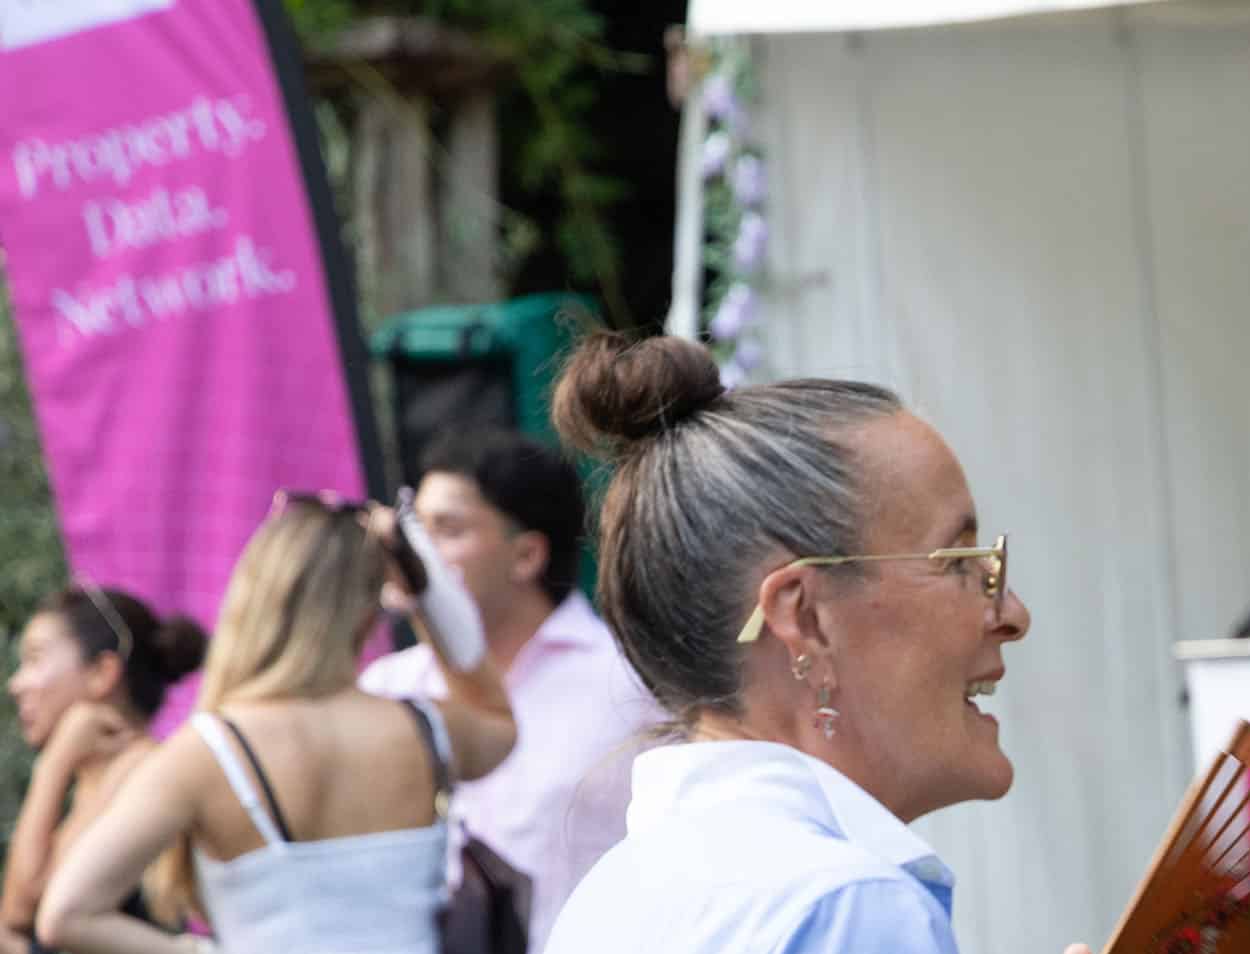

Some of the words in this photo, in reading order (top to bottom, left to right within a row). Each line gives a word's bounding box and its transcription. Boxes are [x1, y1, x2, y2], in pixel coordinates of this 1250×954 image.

[12, 94, 268, 199] Property.
[83, 187, 229, 256] Data.
[52, 236, 297, 335] Network.
